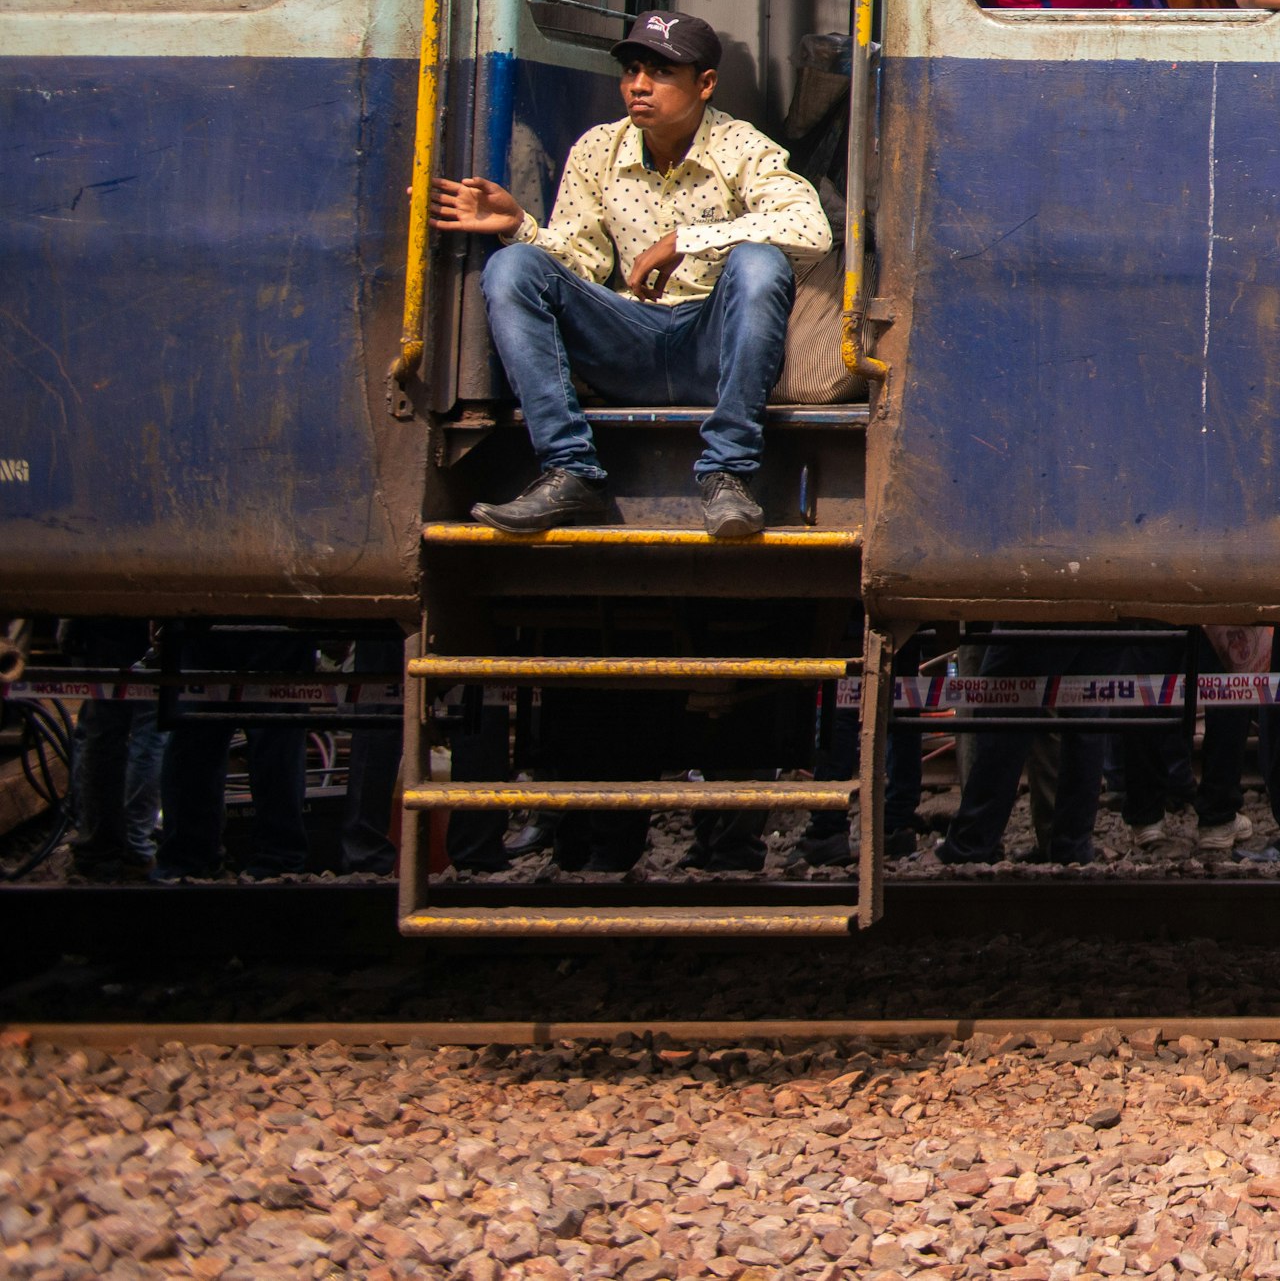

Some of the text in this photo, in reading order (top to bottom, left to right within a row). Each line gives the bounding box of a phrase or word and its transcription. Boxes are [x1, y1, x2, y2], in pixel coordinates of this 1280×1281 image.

[949, 679, 1036, 691] DO NOT CROSS
[1227, 676, 1250, 687] NOT
[1253, 675, 1269, 686] DO
[1082, 680, 1135, 699] RPF
[1200, 689, 1253, 700] CAUTION
[965, 692, 1020, 703] CAUTION
